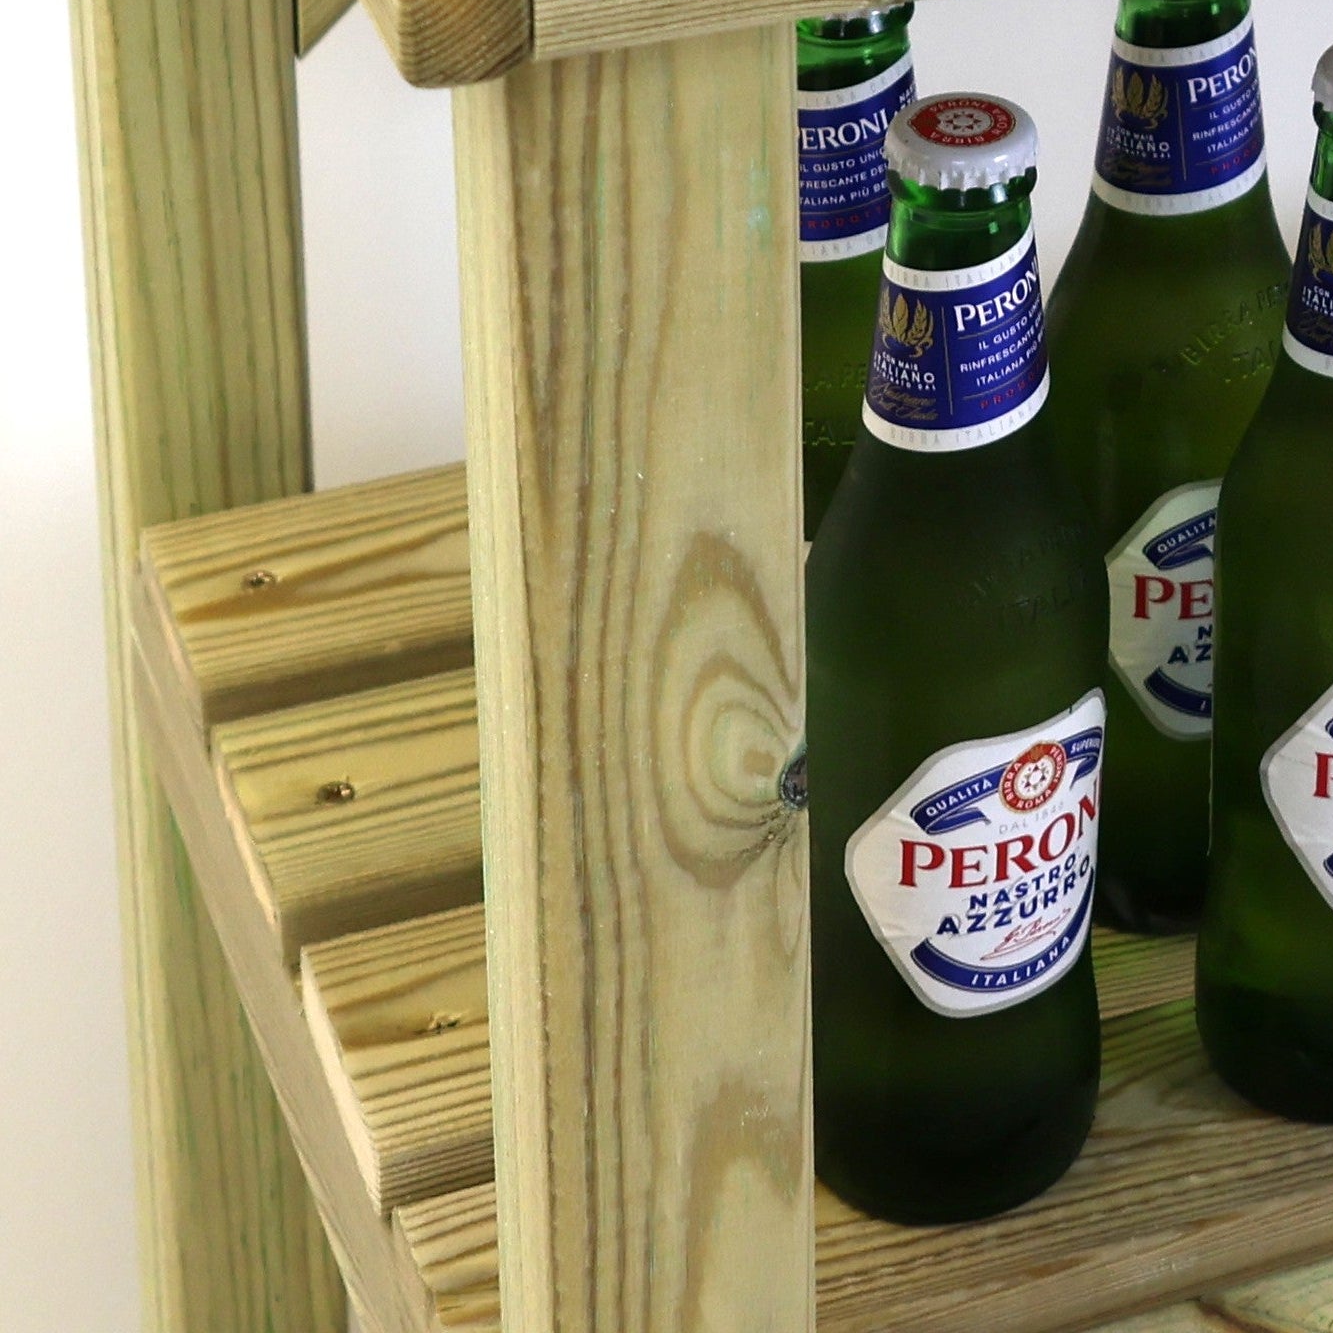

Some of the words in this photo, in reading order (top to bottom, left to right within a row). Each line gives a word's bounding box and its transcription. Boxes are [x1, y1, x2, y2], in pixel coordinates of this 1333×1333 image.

[1209, 111, 1218, 120] IL
[1222, 90, 1251, 115] GUSTO
[800, 108, 889, 151] ERONI
[1108, 126, 1170, 152] ITALIANO
[1207, 127, 1250, 154] ITALIANA
[800, 171, 868, 190] FRESCANTE
[812, 158, 856, 173] GUSTO
[850, 186, 870, 202] PIÙ
[960, 325, 1035, 373] RINFRESCANTE
[978, 339, 990, 351] IL
[993, 316, 1029, 345] GUSTO
[874, 350, 935, 384] ITALIANO
[882, 351, 896, 365] CON
[898, 359, 918, 372] MAIS
[976, 356, 1026, 387] ITALIANA
[1003, 761, 1022, 801] BIRRA
[1016, 789, 1052, 809] ROMA
[936, 855, 1090, 936] AZZURRO
[970, 853, 1076, 911] NASTRO
[970, 935, 1070, 986] ITALIANA
